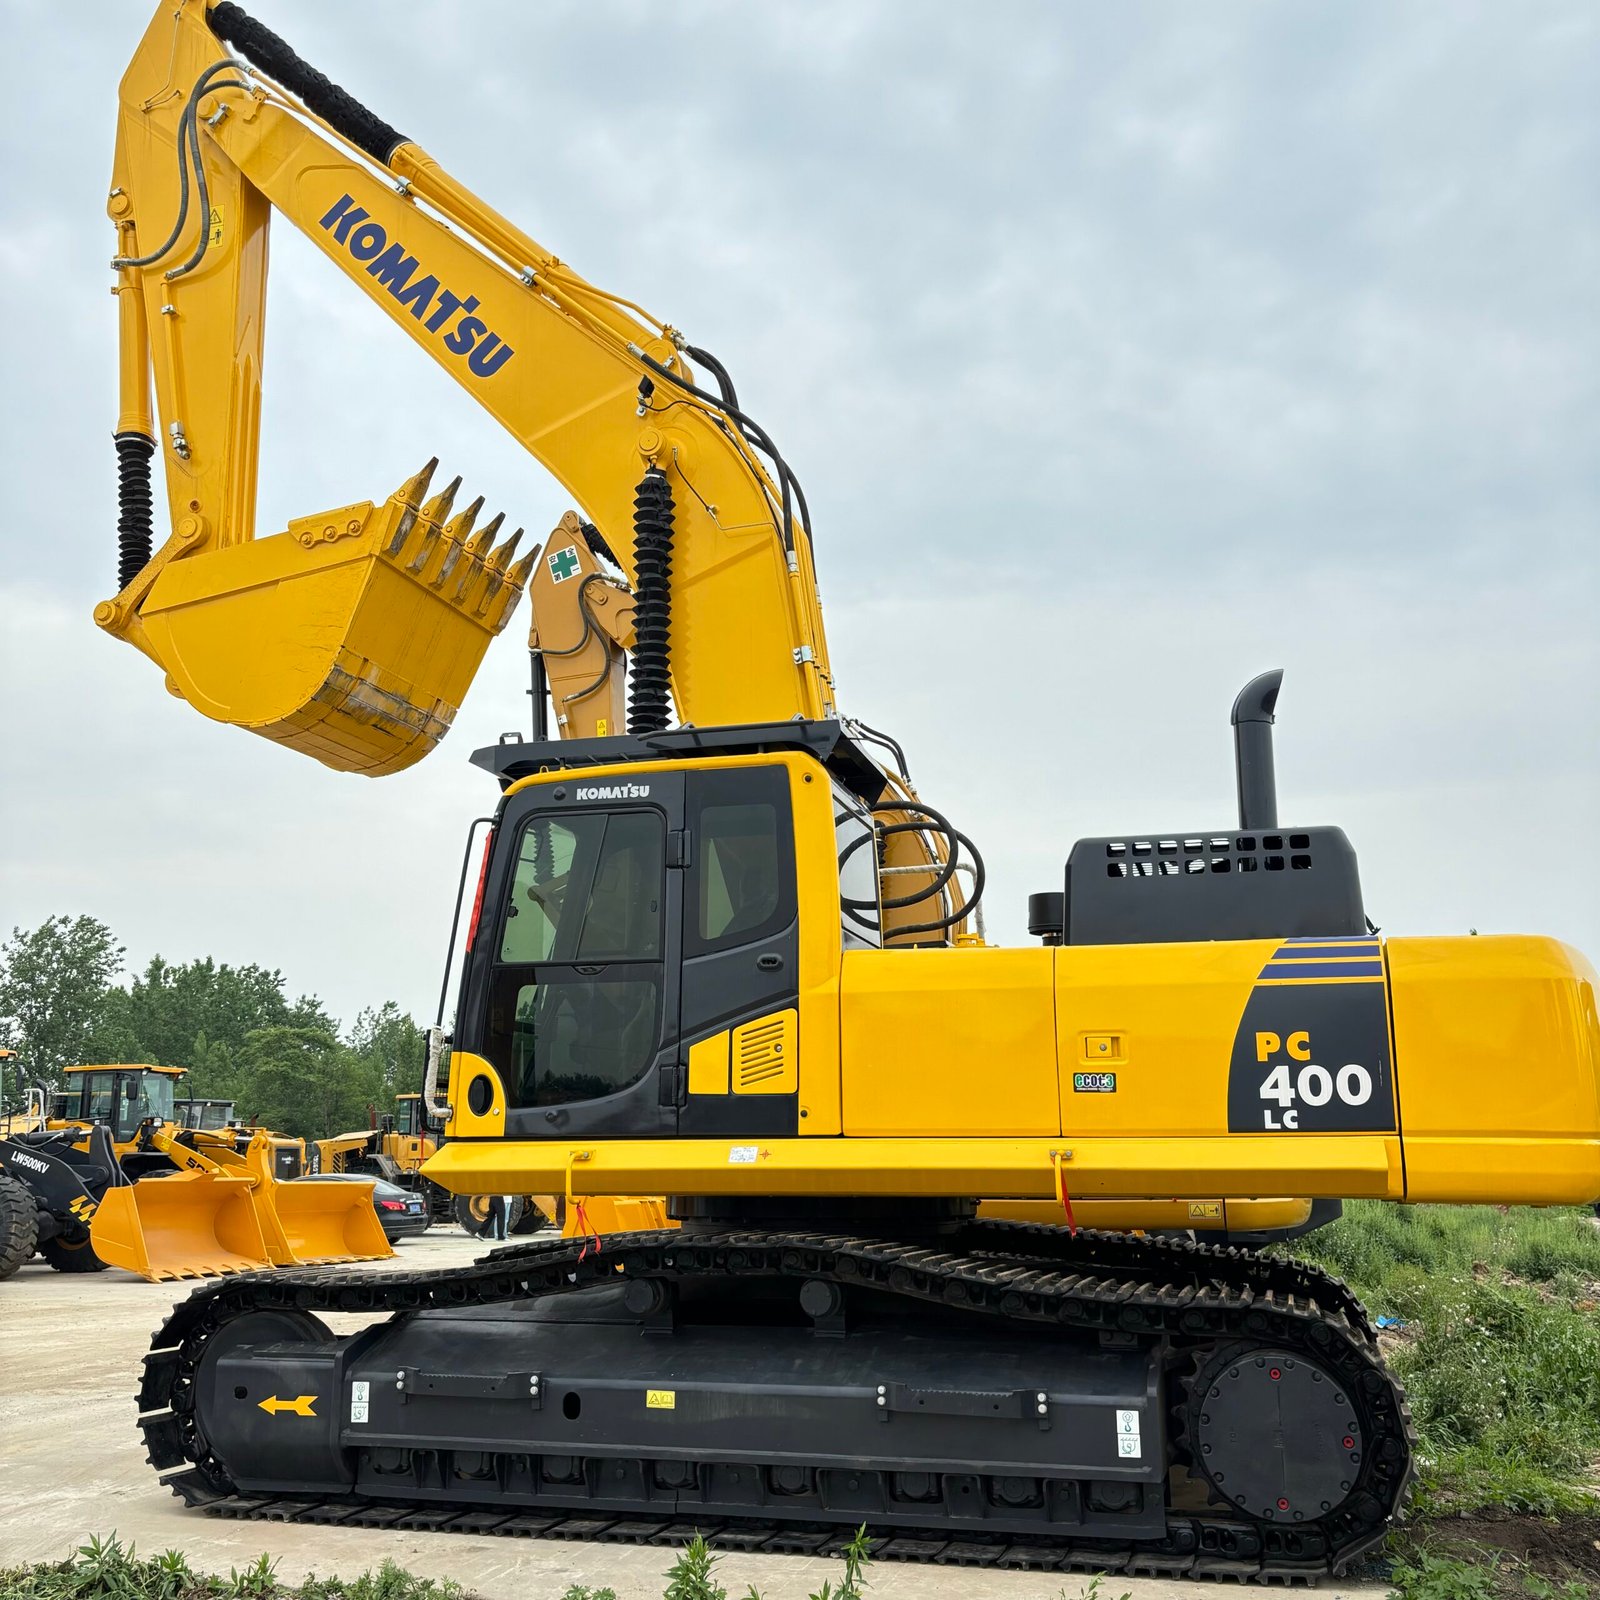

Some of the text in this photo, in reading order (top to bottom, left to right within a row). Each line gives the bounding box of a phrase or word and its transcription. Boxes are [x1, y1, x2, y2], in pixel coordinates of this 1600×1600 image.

[319, 193, 515, 377] KOMATSU
[576, 783, 650, 801] KOMATSU
[1255, 1031, 1311, 1062] PC
[1259, 1064, 1372, 1107] 400
[1264, 1109, 1299, 1130] LC
[11, 1150, 50, 1174] LW500KV
